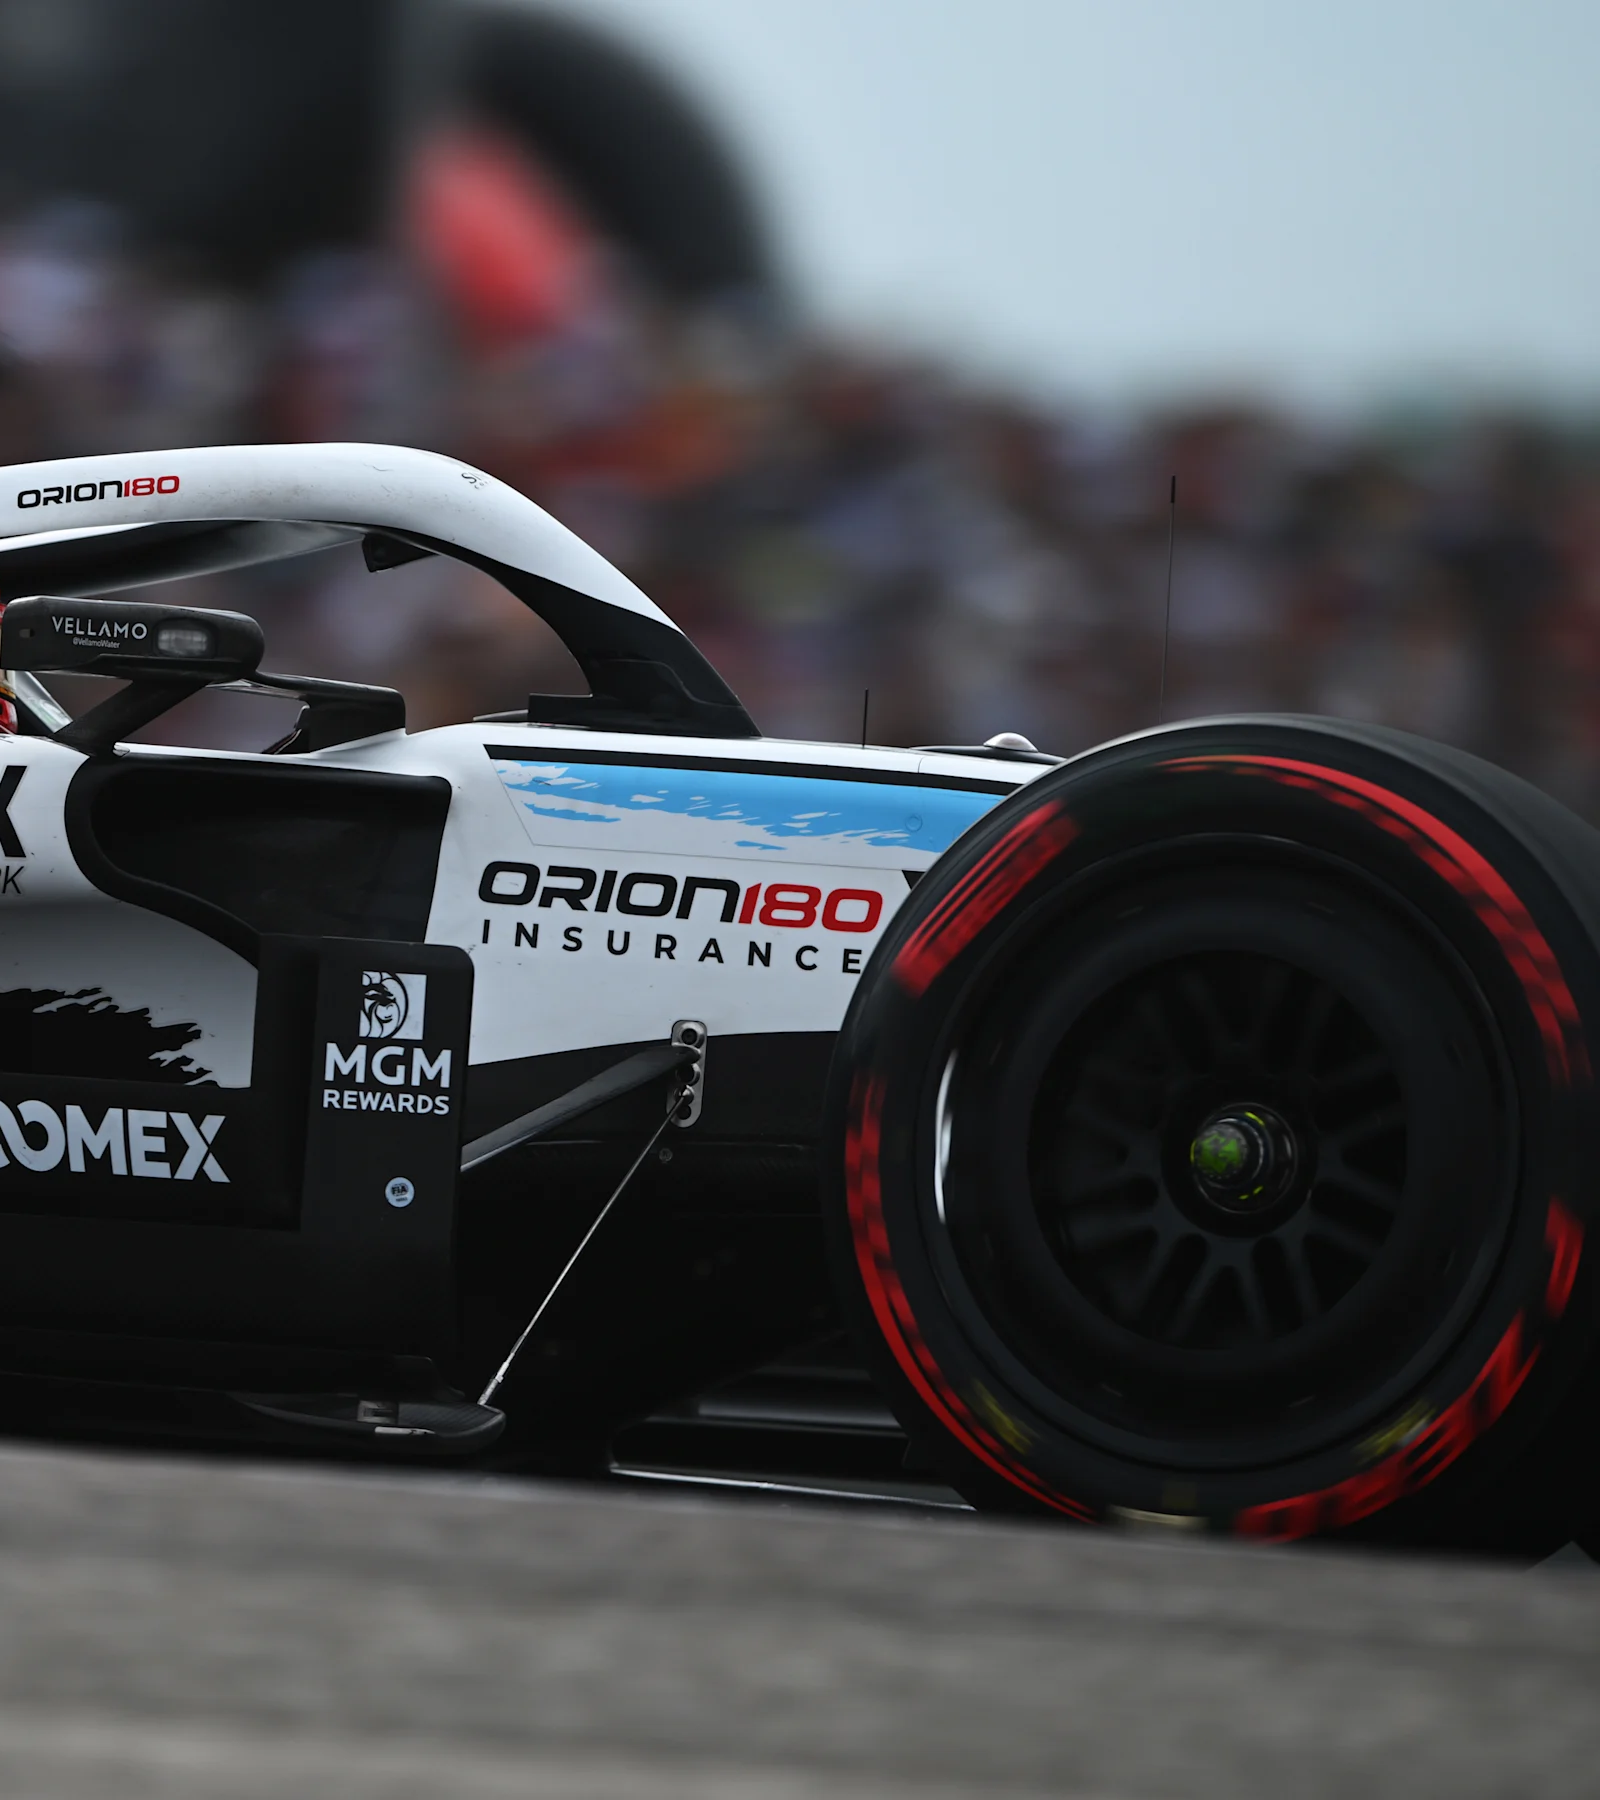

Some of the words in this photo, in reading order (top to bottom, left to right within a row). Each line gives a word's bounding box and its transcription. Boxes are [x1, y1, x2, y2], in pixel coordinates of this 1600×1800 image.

[17, 475, 180, 509] ORION180
[52, 616, 148, 640] VELLAMO
[72, 637, 120, 649] @VellamoWater
[478, 860, 884, 934] ORION180
[481, 918, 863, 974] INSURANCE
[324, 1042, 452, 1088] MGM
[323, 1089, 450, 1115] REWARDS
[391, 1185, 409, 1195] FIA
